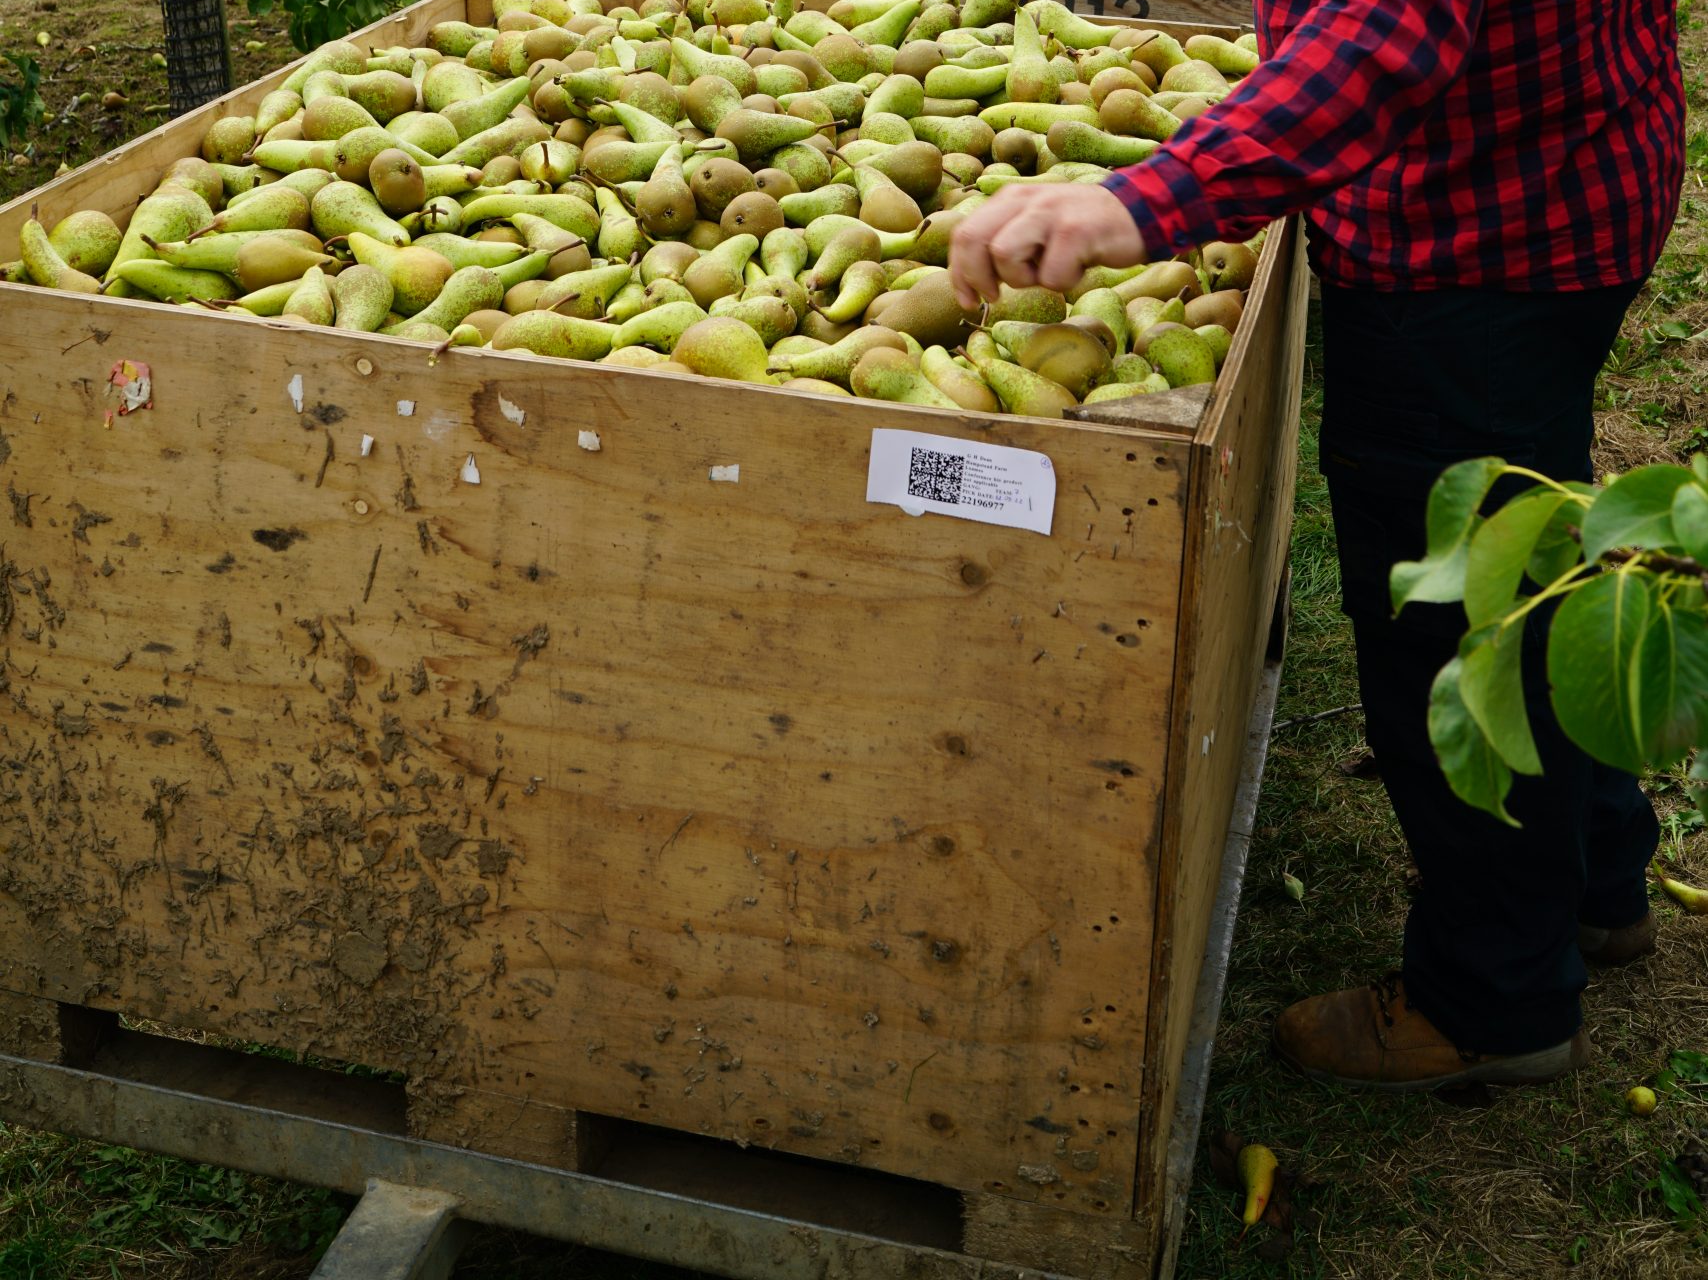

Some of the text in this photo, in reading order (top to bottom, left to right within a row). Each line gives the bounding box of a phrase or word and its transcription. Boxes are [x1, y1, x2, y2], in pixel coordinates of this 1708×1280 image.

[979, 455, 993, 463] Dean
[964, 471, 992, 481] Conference
[1003, 478, 1024, 486] product
[973, 479, 999, 488] applicable
[961, 495, 1005, 511] 22196977
